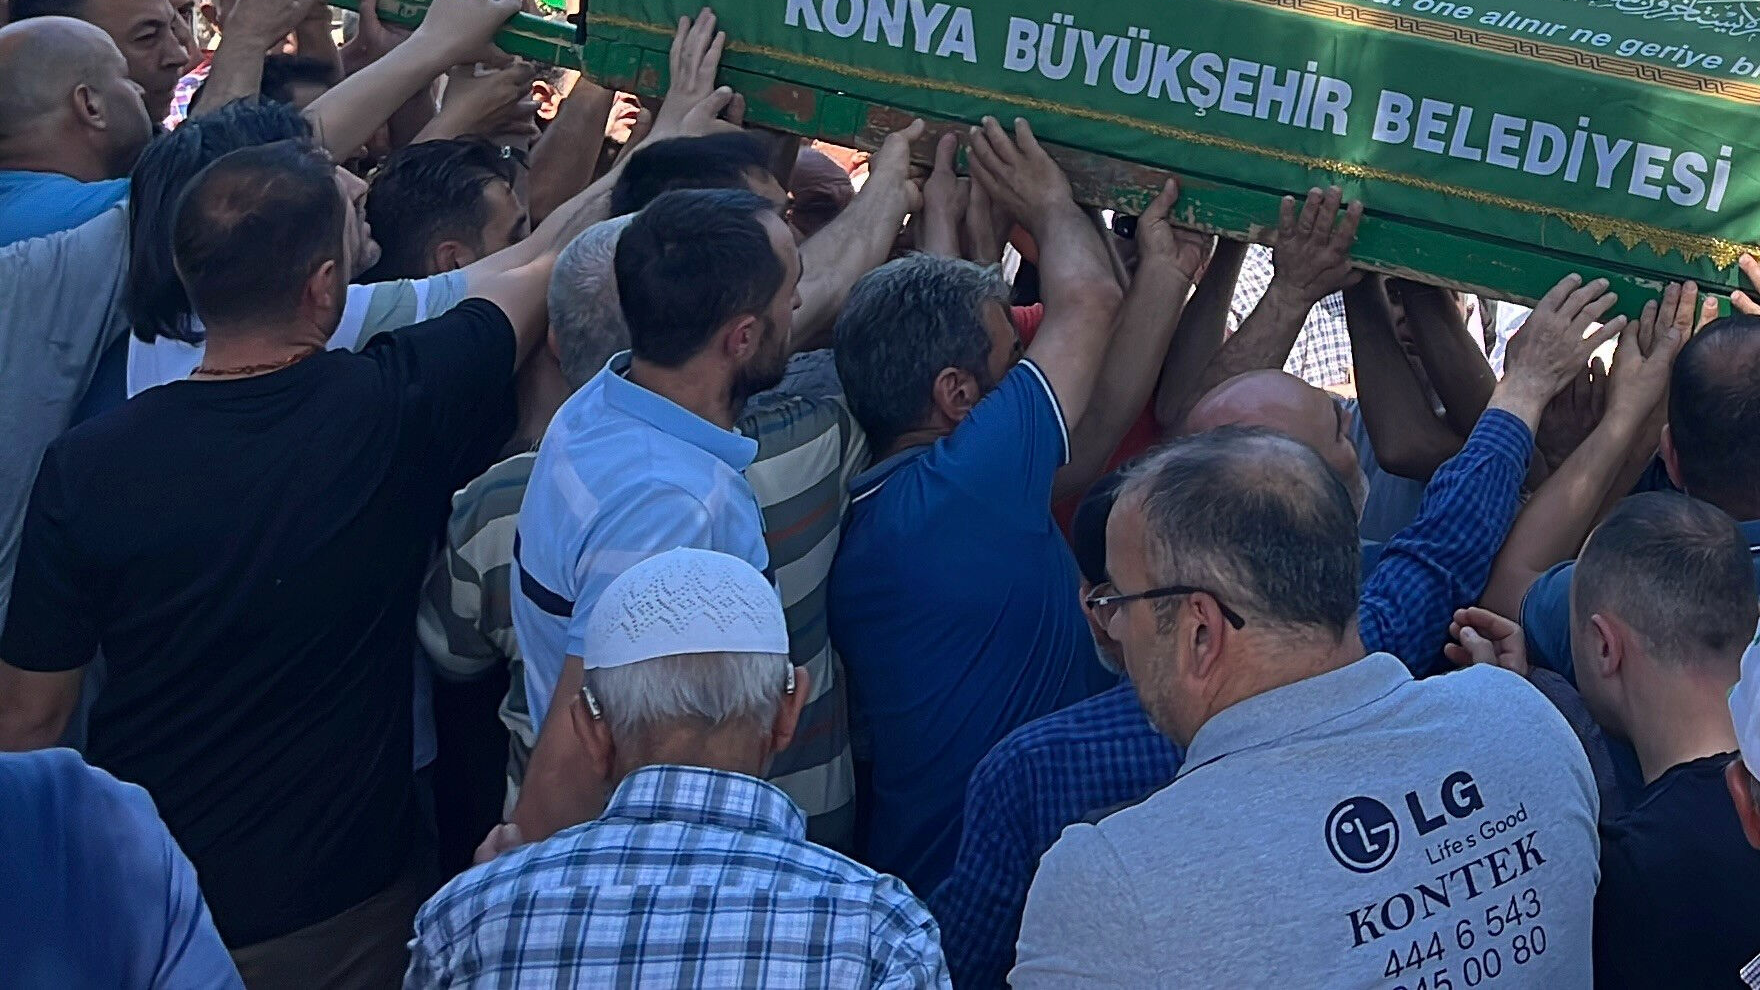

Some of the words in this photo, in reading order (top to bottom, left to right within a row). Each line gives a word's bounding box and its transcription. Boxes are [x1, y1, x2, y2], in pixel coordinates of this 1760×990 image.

[1479, 10, 1566, 40] alınır
[1568, 25, 1613, 49] ne
[1615, 38, 1724, 70] geriye
[1003, 12, 1354, 137] BÜYÜKŞEHİR
[1371, 89, 1734, 213] BELEDİYESİ
[1405, 770, 1485, 836] LG
[1480, 801, 1528, 839] Good
[1346, 830, 1547, 948] KONTEK
[1383, 931, 1445, 979] 444
[1456, 919, 1476, 950] 6
[1485, 887, 1542, 937] 543
[1463, 947, 1501, 987] 00
[1511, 925, 1547, 965] 80
